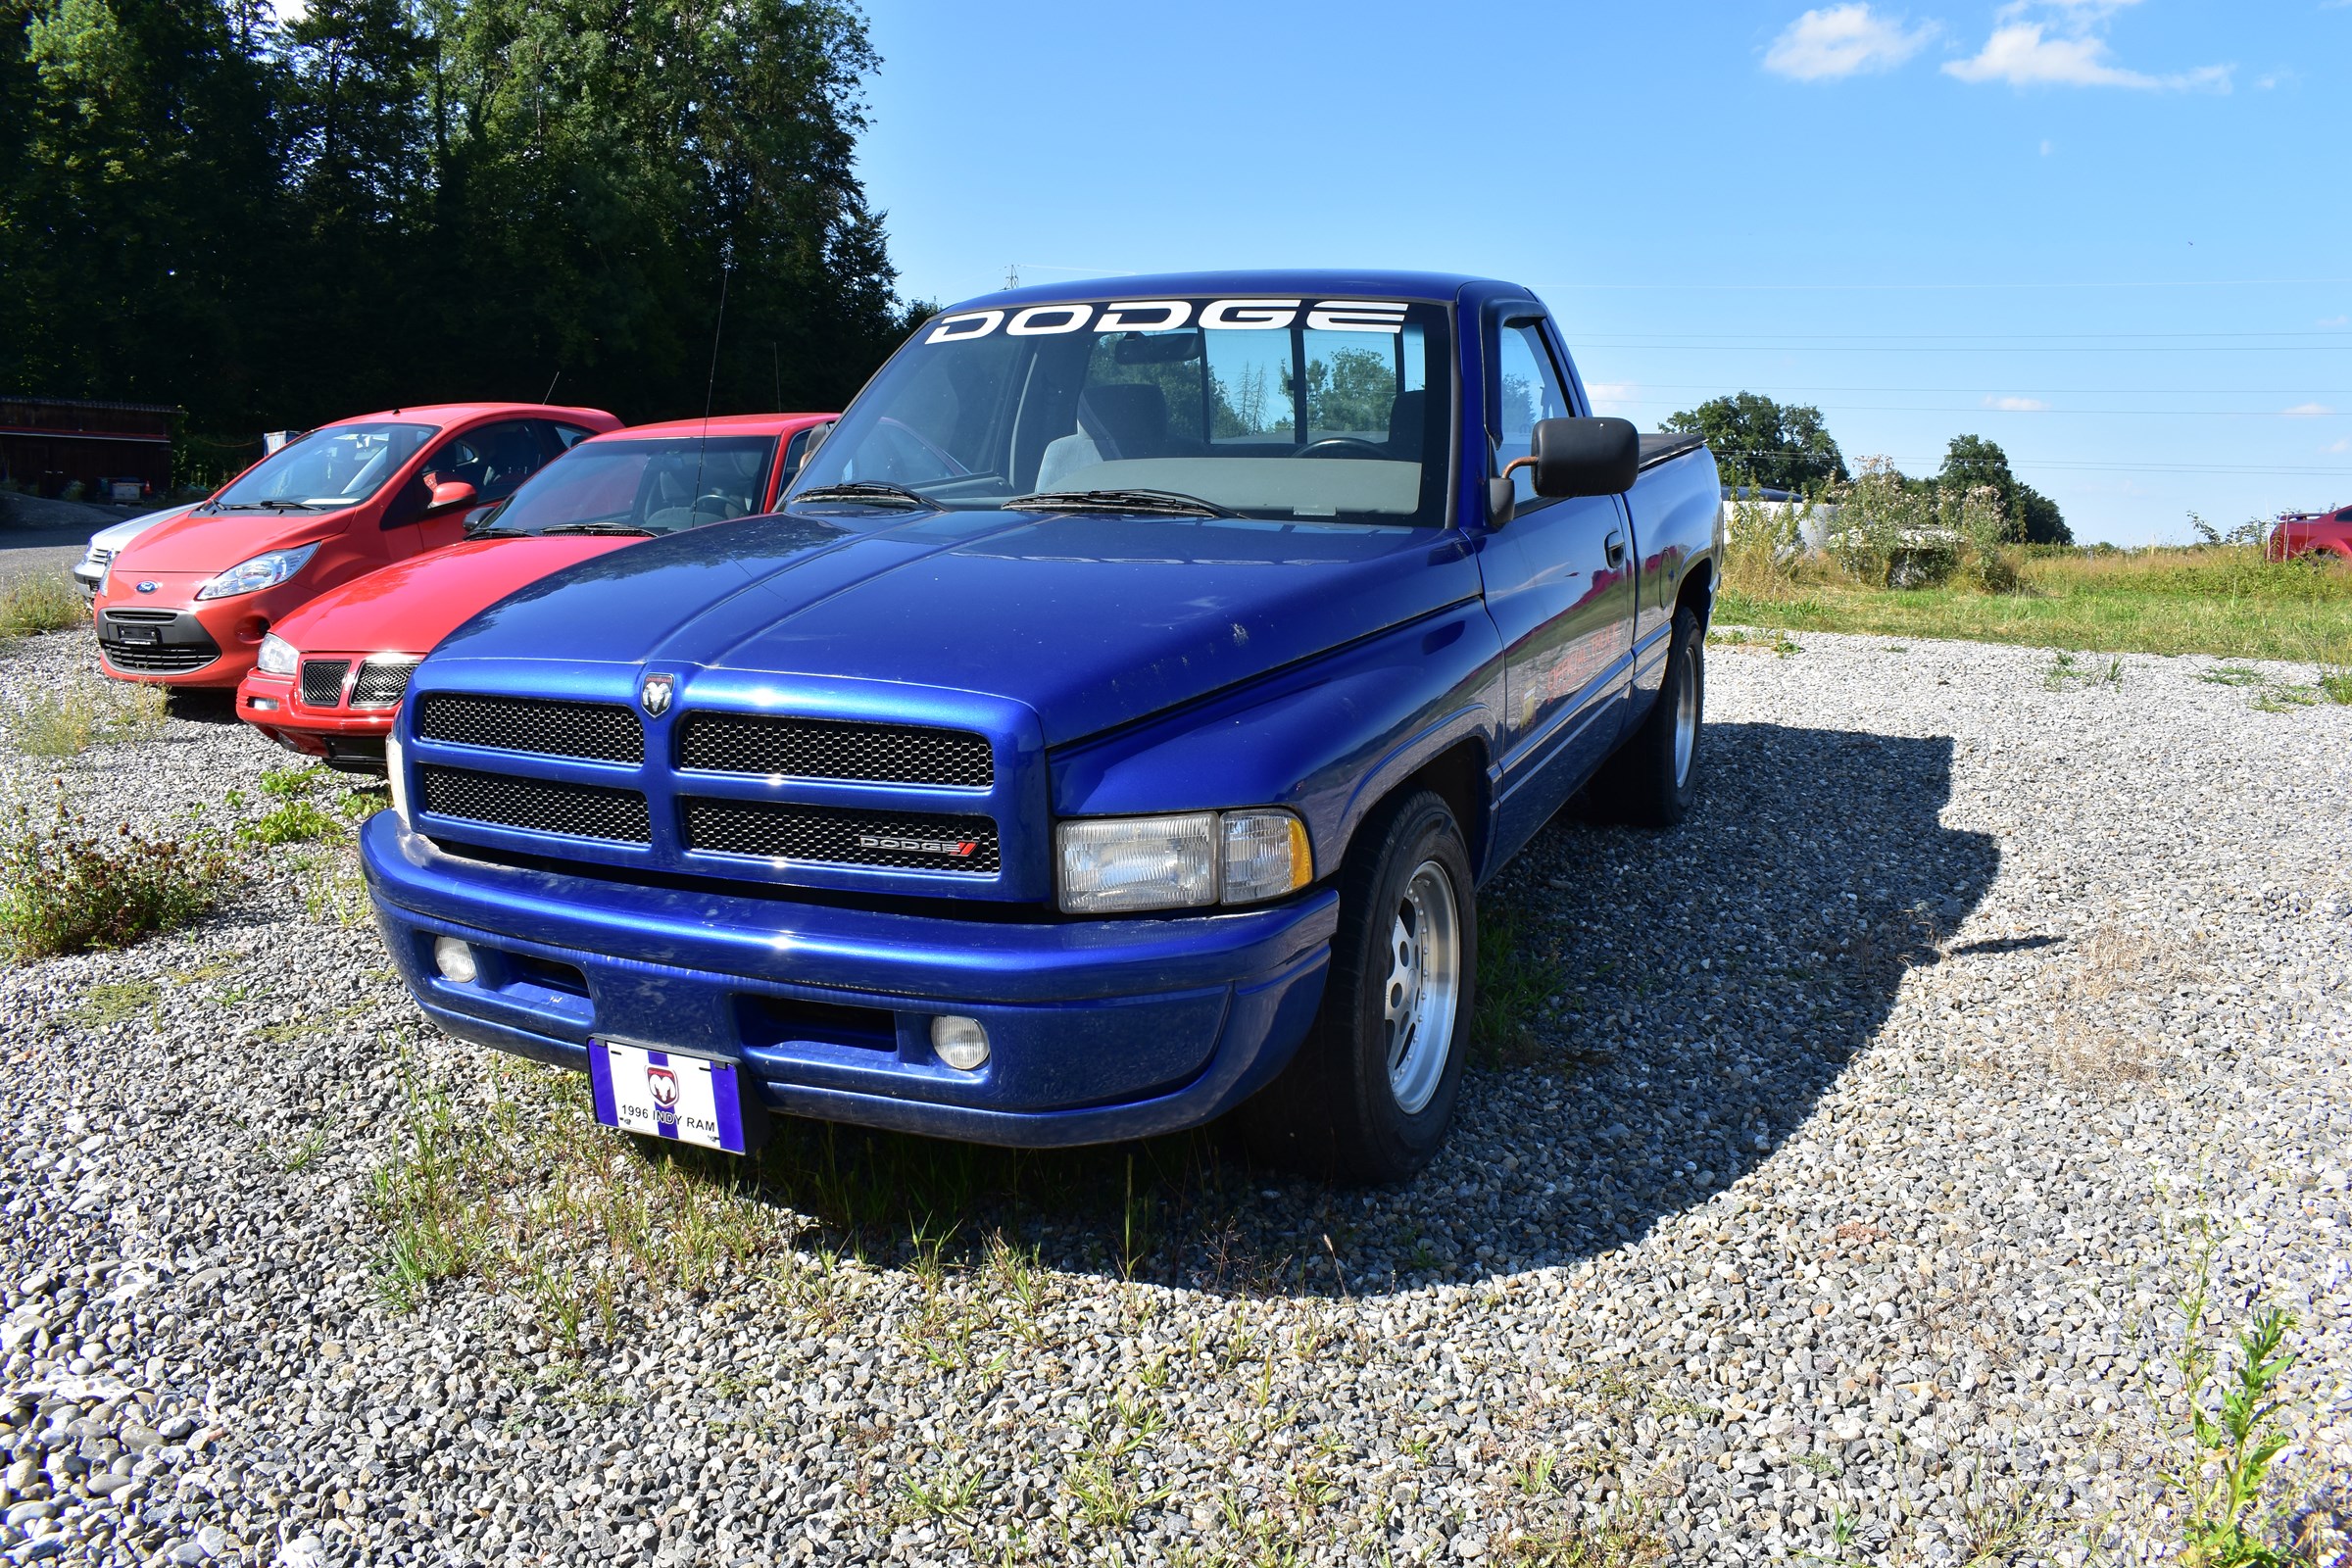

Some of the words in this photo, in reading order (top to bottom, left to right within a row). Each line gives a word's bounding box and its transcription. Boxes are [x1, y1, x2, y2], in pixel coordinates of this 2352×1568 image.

[925, 299, 1409, 345] DODGE
[859, 837, 961, 853] DODGE
[621, 1104, 649, 1119] 1996
[653, 1110, 683, 1126] INDY
[686, 1116, 715, 1132] RAM
